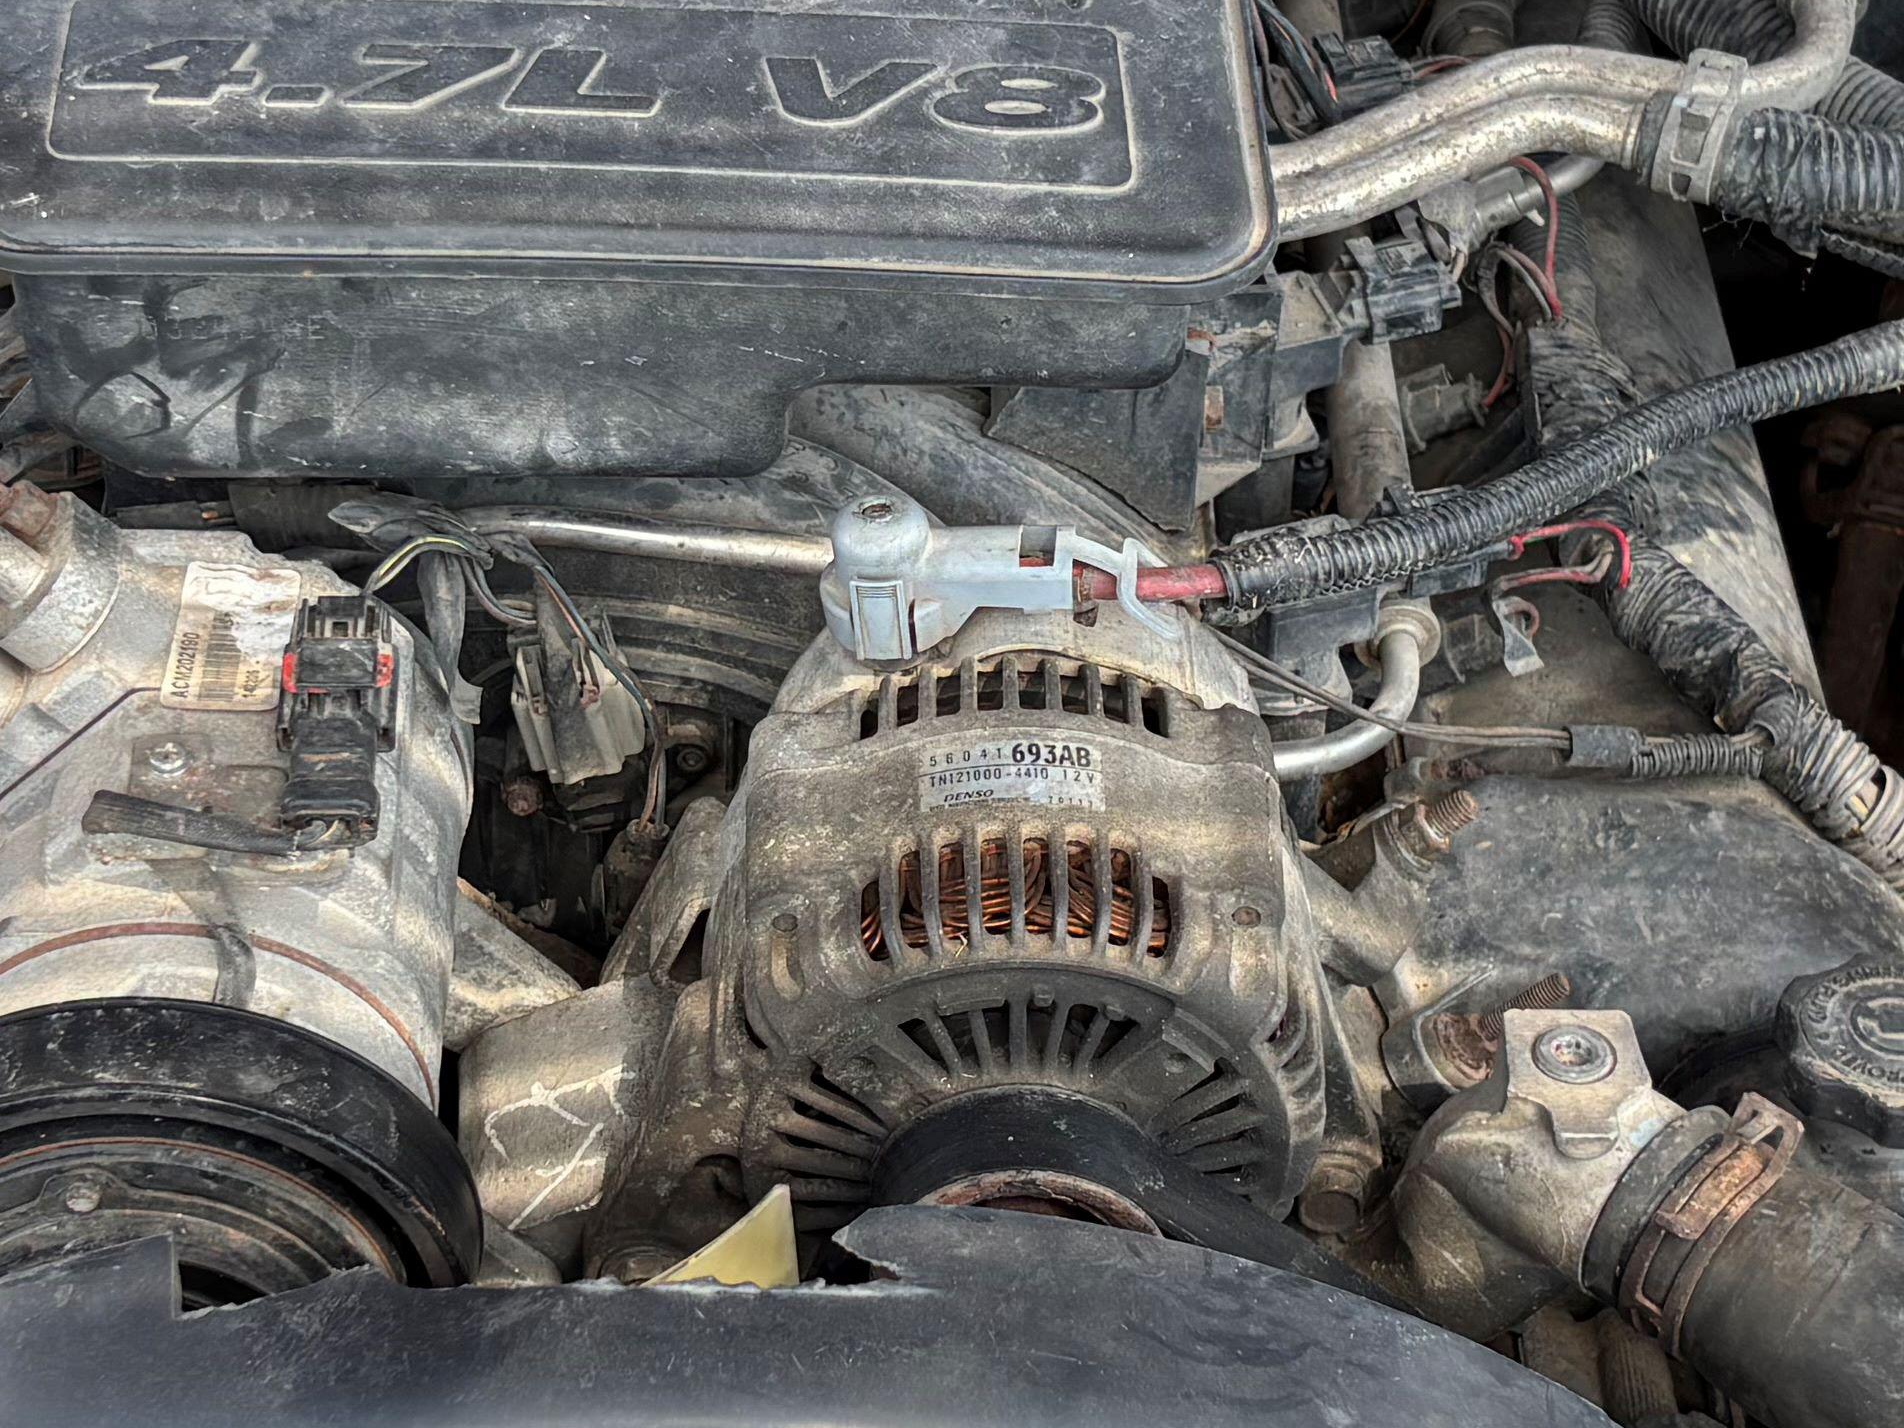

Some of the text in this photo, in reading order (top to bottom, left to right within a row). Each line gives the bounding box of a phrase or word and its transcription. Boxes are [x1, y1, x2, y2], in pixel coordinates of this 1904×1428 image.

[76, 38, 1107, 135] 4.7L V8
[1011, 741, 1091, 768] 693AB
[943, 789, 994, 802] DENSO
